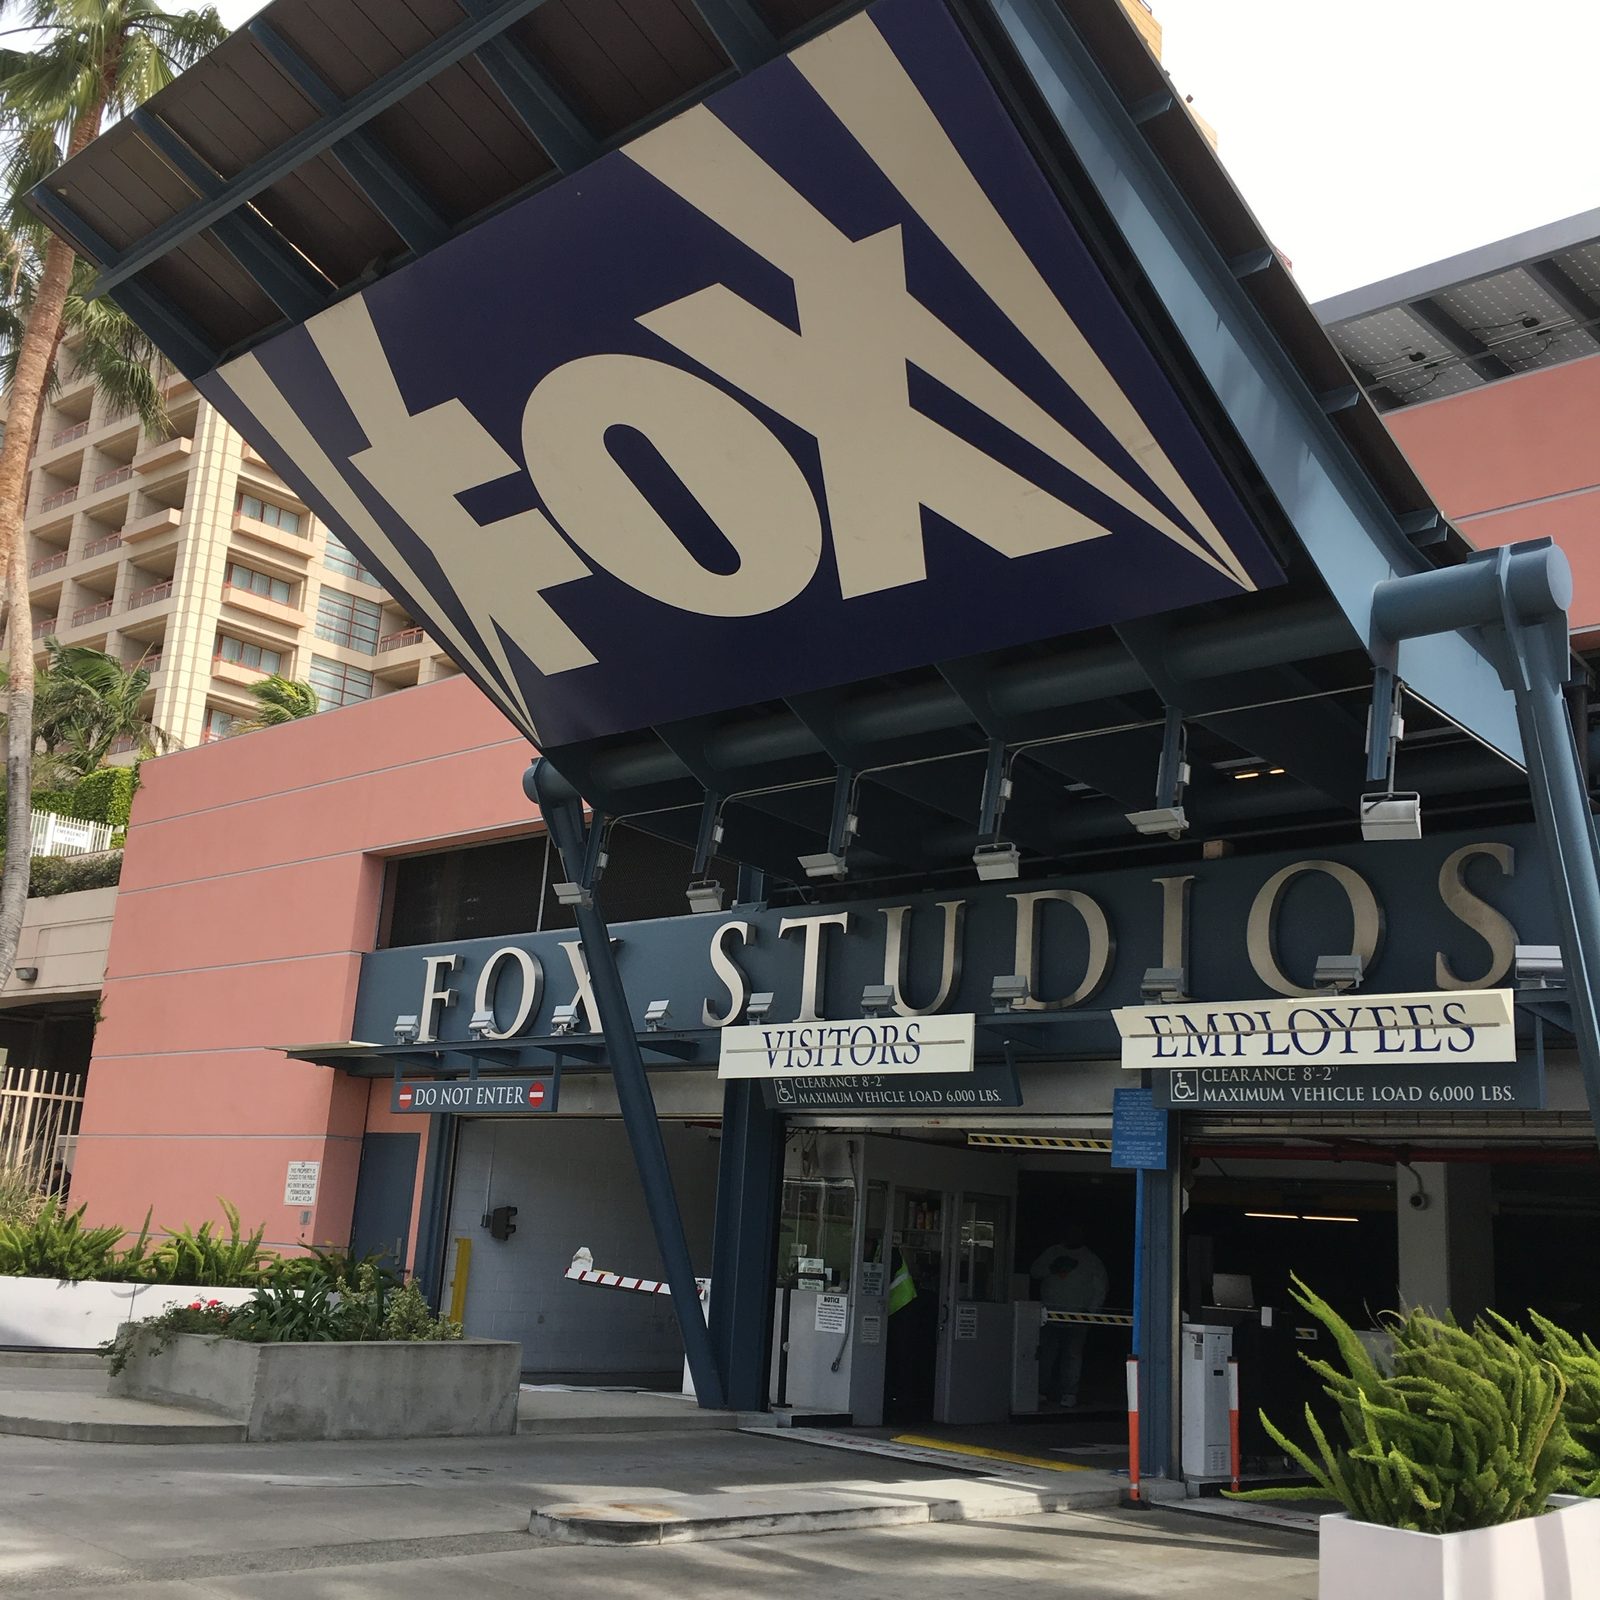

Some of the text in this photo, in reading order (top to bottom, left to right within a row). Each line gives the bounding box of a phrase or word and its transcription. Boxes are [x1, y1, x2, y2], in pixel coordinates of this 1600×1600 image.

[348, 222, 1112, 677] FOX
[416, 842, 1521, 1044] FOX STUDIOS
[1145, 1002, 1475, 1058] EMPLOYEES
[762, 1022, 921, 1069] VISITORS
[794, 1075, 885, 1089] CLEARANCE 8'-2"
[1201, 1066, 1339, 1083] CLEARANCE 8'-2"
[414, 1086, 525, 1106] DO NOT ENTER
[797, 1089, 1002, 1104] MAXIMUM VEHICLE LOAD 6,000 LBS.
[1202, 1085, 1516, 1102] MAXIMUM VEHICLE LOAD 6,000 LBS.
[823, 1296, 840, 1304] NOTICE
